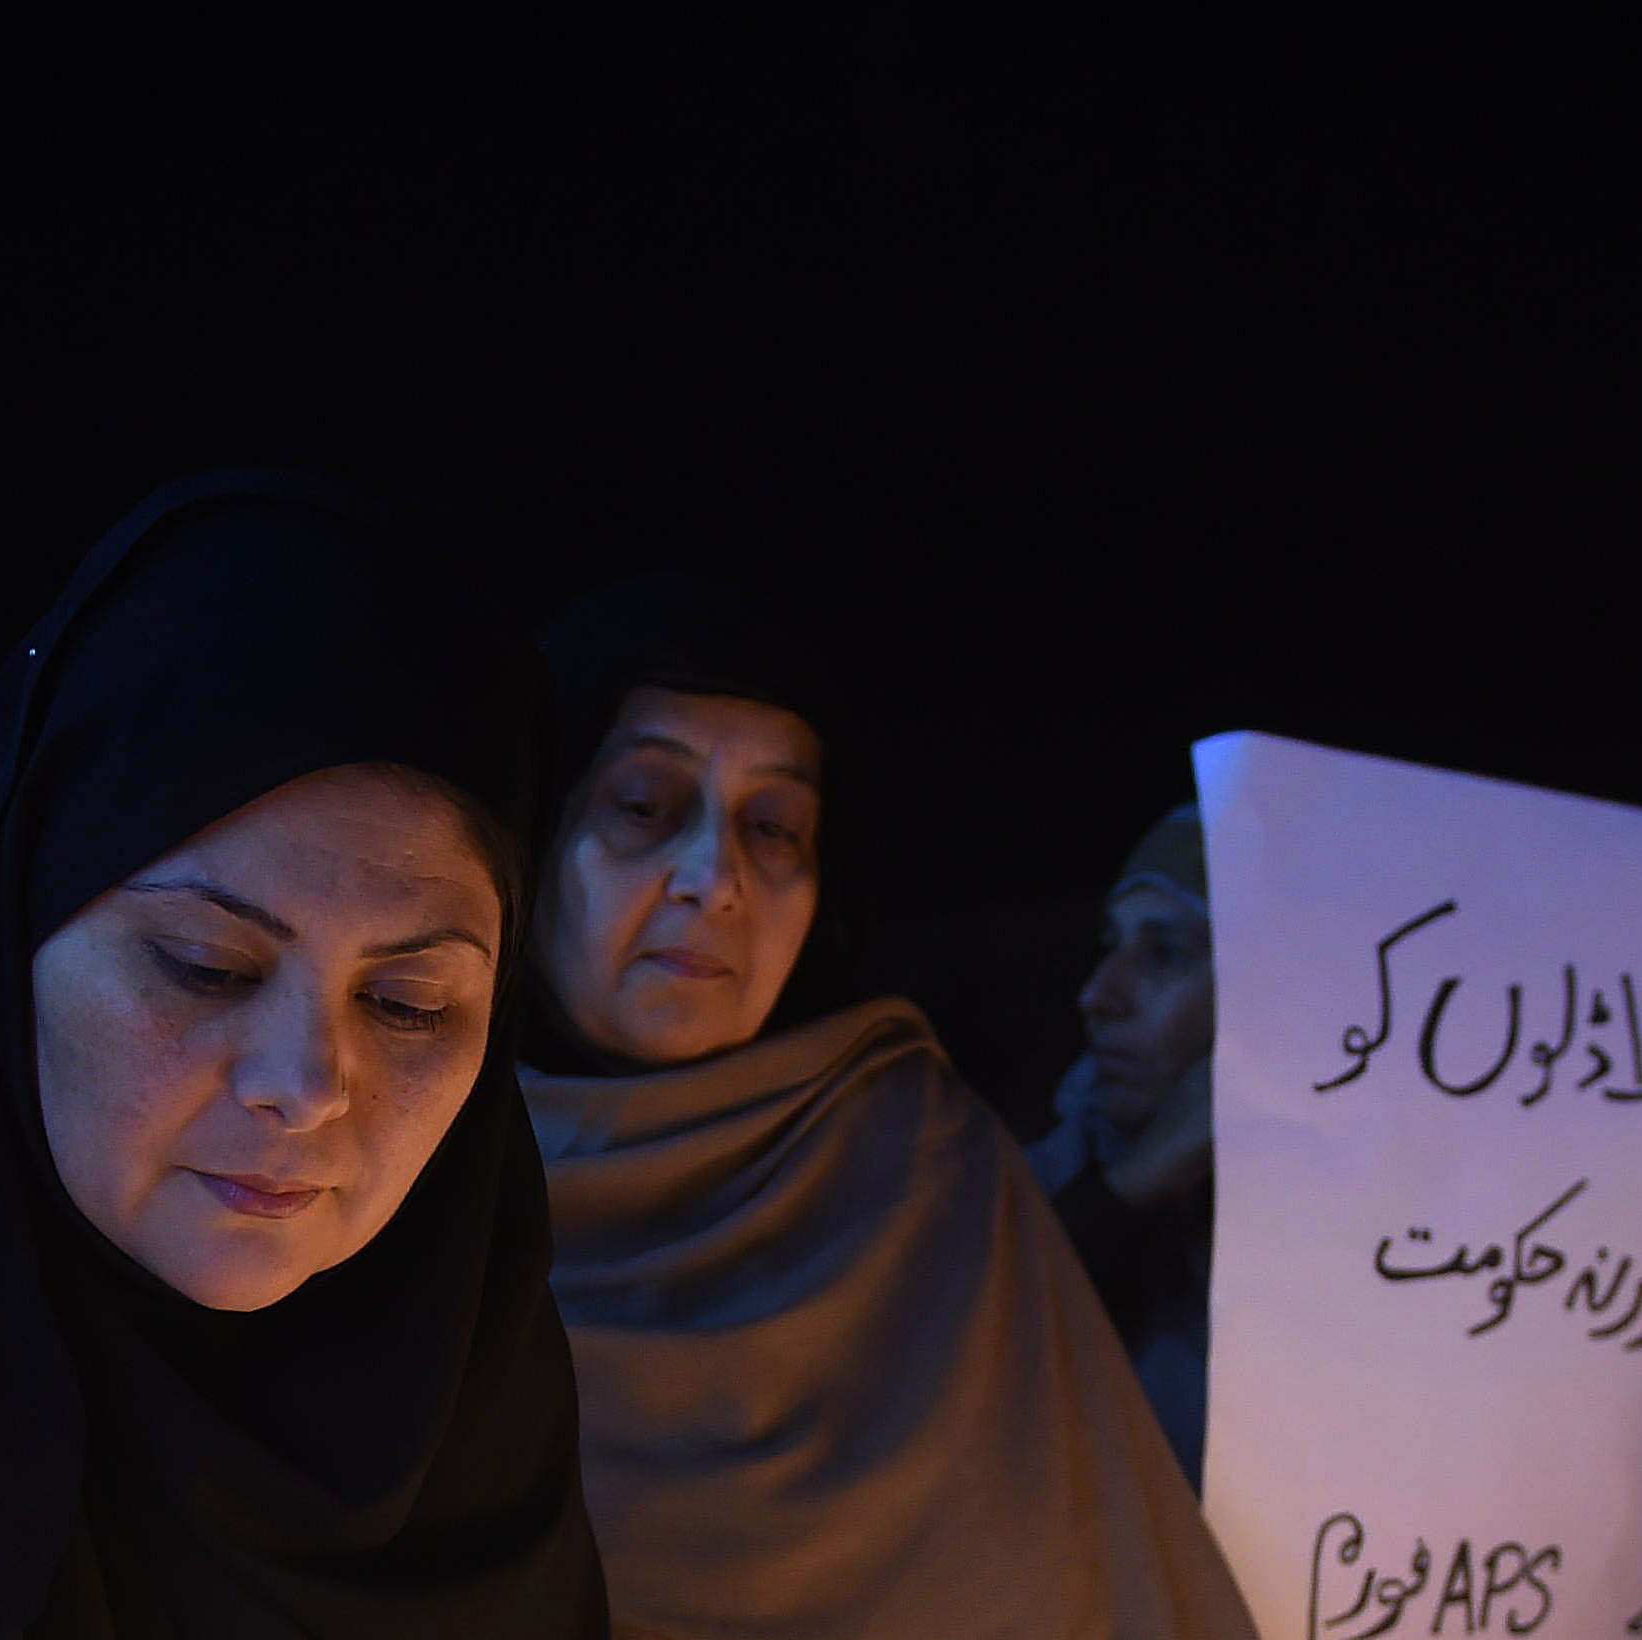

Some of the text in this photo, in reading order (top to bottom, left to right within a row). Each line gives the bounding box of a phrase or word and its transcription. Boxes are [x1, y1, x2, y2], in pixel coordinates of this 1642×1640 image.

[1311, 898, 1458, 1092] کو
[1372, 1178, 1589, 1338] حکومت
[1429, 1538, 1562, 1635] APS
